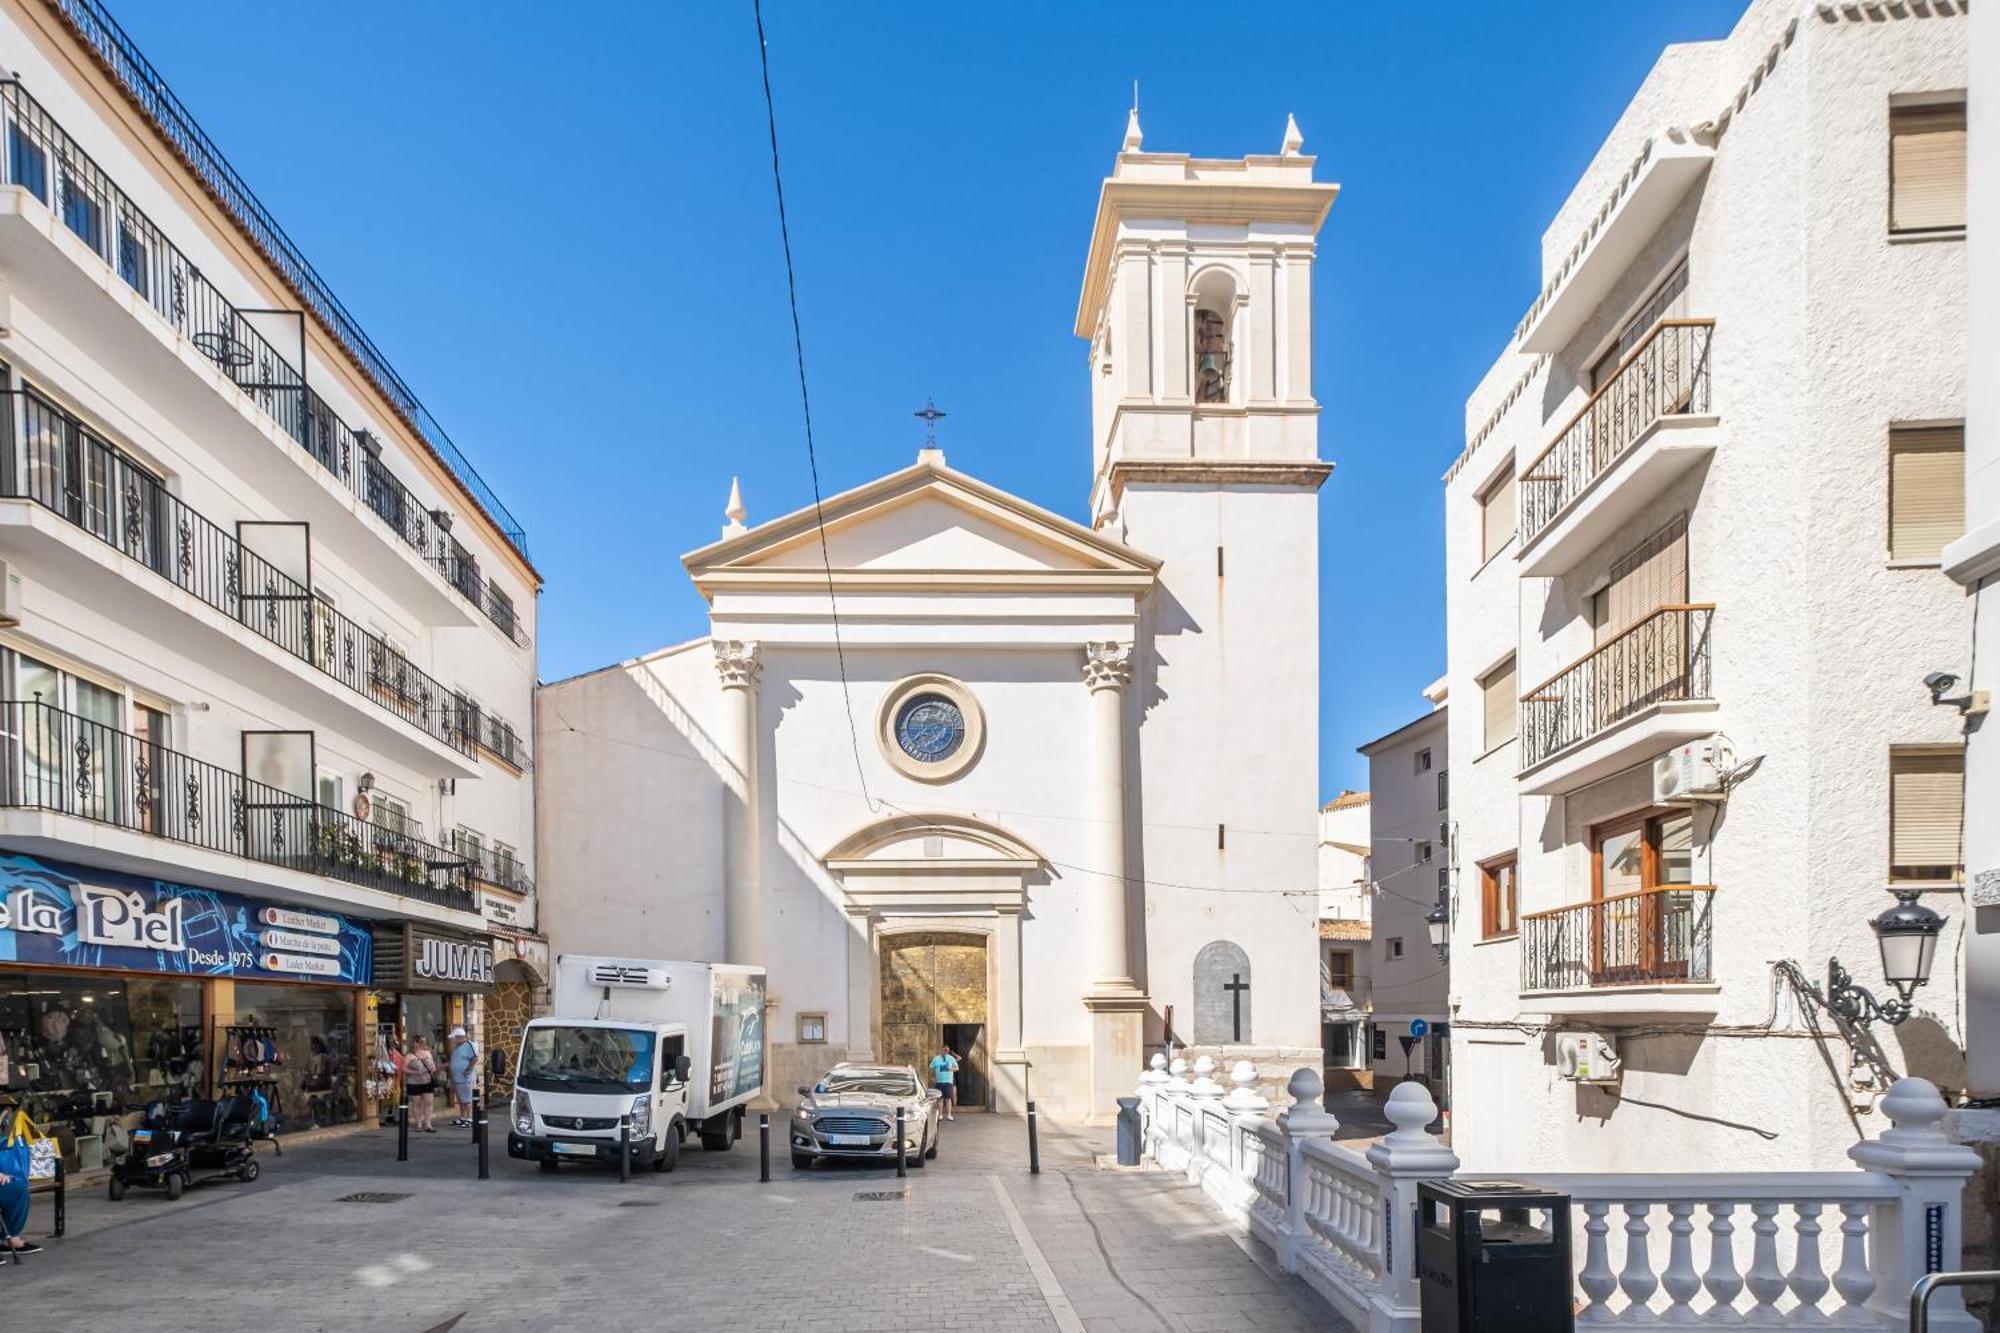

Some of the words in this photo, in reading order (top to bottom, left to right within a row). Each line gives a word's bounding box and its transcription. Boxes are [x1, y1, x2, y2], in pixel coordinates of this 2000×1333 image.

[20, 890, 61, 932] la
[84, 887, 182, 949] Piel
[188, 947, 224, 965] Desde
[228, 951, 253, 968] 1975
[416, 939, 495, 983] JUMAR
